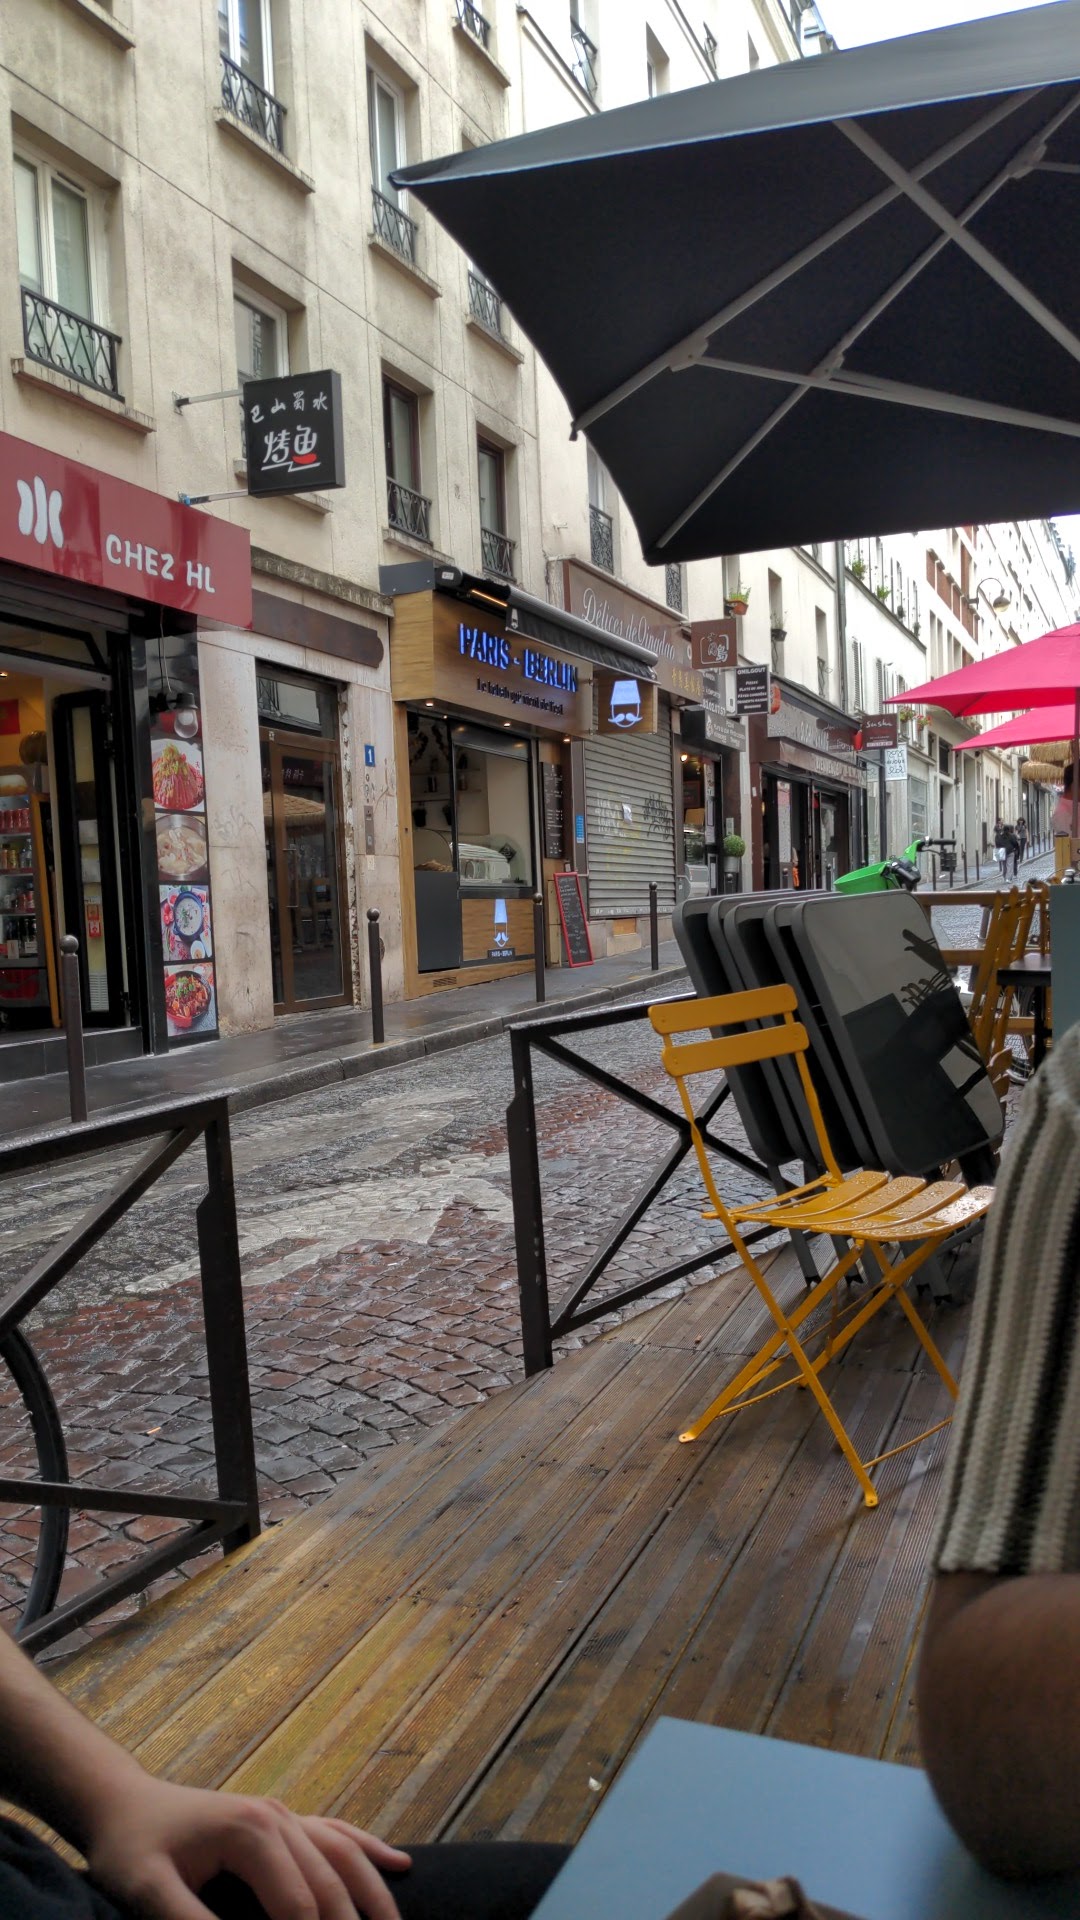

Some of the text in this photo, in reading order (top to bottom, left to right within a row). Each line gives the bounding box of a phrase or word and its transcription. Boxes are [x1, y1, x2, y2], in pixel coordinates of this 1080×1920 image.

[250, 390, 328, 424] 巴山蜀水
[262, 424, 318, 465] 烤鱼
[106, 534, 216, 594] CHEZ HL
[459, 622, 510, 670] PARIS
[523, 648, 578, 693] BERLIN
[367, 749, 373, 763] 1
